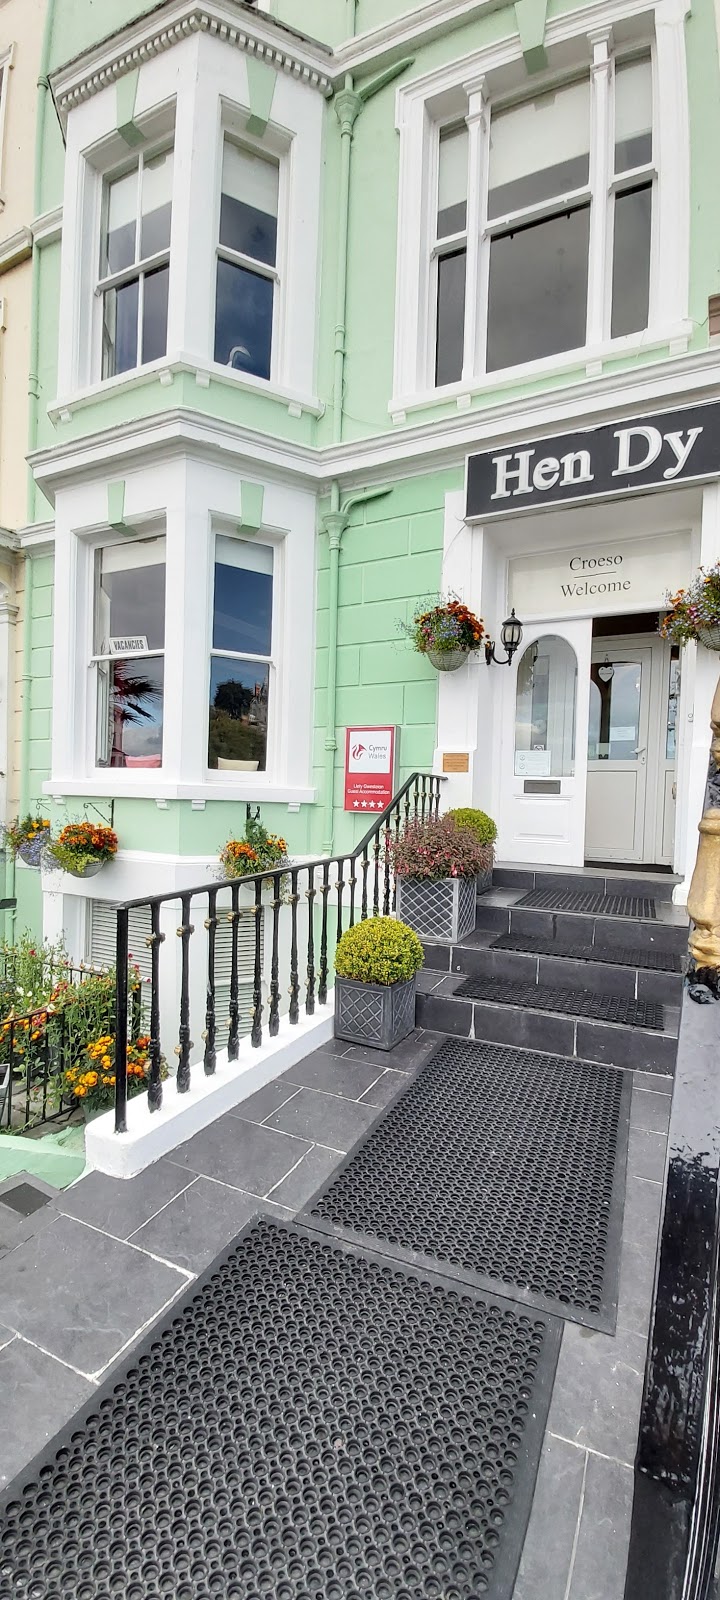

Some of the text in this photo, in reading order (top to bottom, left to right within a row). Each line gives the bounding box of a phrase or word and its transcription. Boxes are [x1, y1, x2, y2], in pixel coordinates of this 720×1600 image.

[490, 425, 703, 500] Hen Dy
[569, 554, 623, 571] Croeso
[561, 577, 631, 598] Welcome
[113, 639, 144, 651] VACANCIES
[368, 744, 388, 752] Cymru
